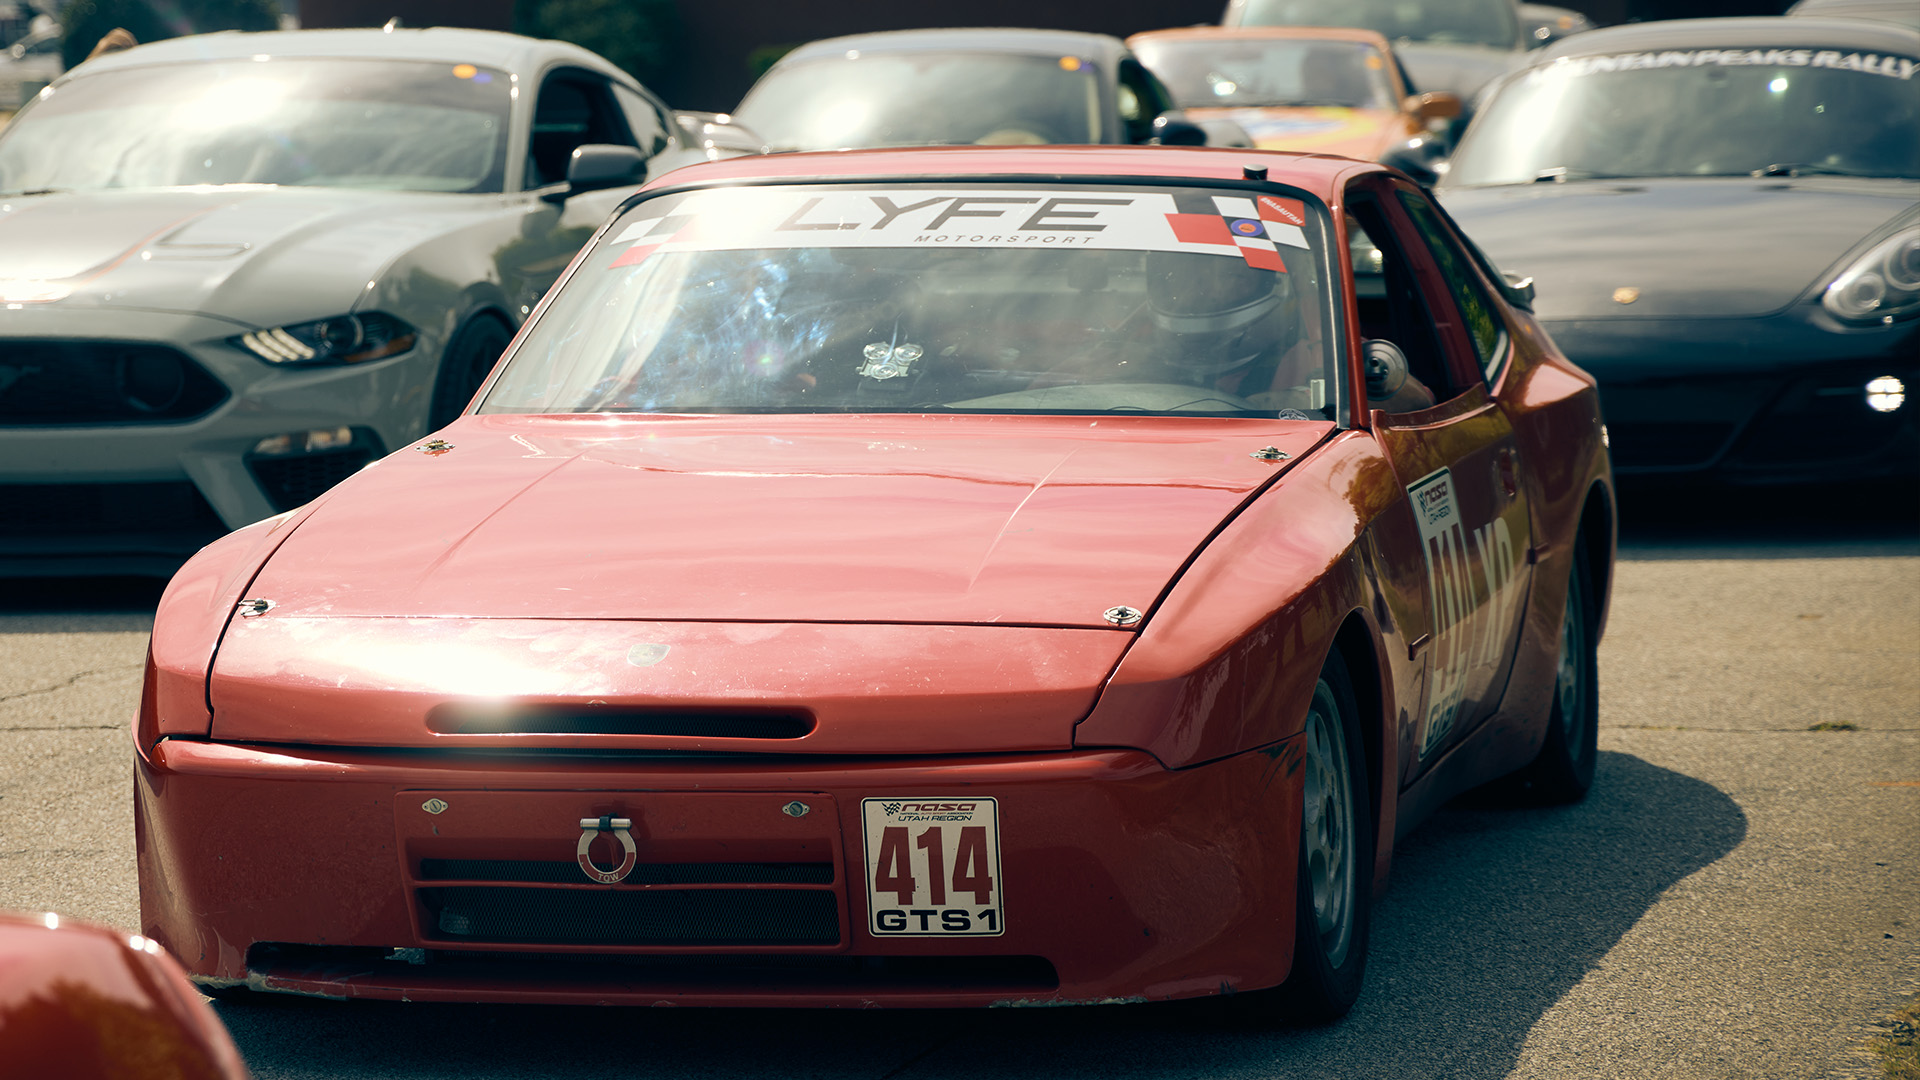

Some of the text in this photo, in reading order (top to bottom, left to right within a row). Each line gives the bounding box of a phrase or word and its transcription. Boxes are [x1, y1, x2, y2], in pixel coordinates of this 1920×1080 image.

[1692, 49, 1813, 66] PEAKS
[1811, 51, 1920, 80] RALLY
[775, 197, 1135, 232] LYFE
[1260, 196, 1303, 225] #NASAUTAH
[914, 234, 1096, 245] MOTORSPORT
[1473, 517, 1515, 670] XP
[901, 803, 977, 812] nasa
[598, 873, 619, 882] TOW
[875, 826, 993, 905] 414
